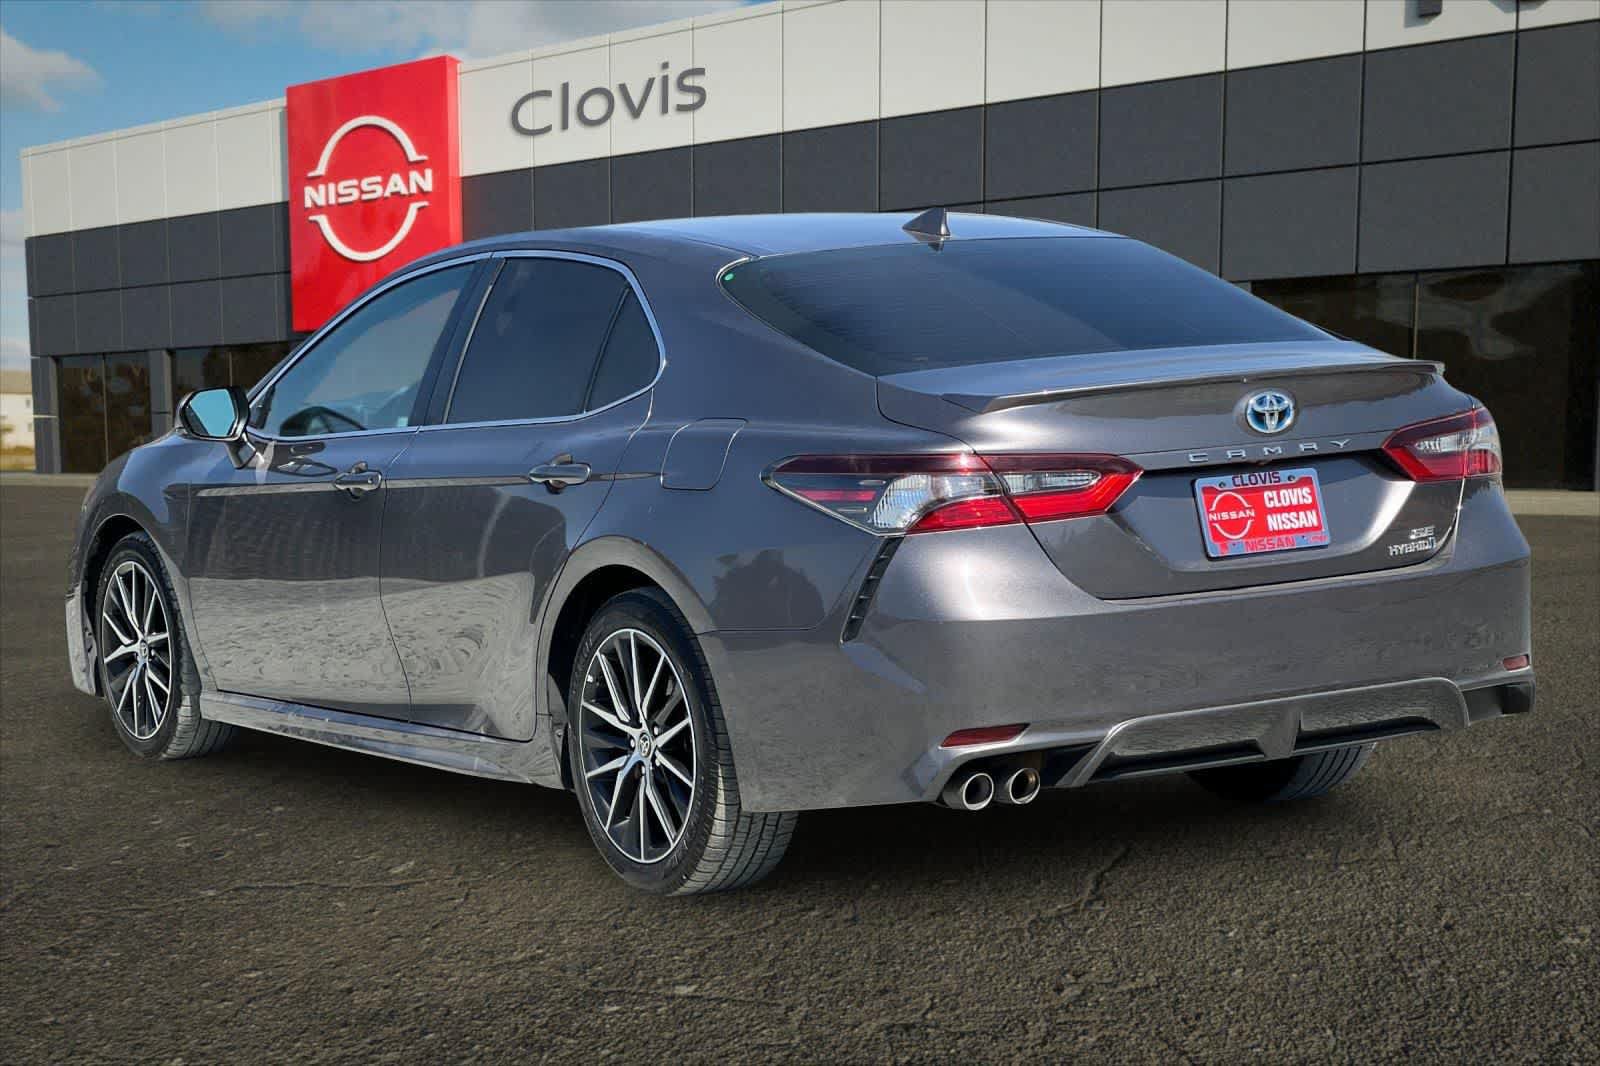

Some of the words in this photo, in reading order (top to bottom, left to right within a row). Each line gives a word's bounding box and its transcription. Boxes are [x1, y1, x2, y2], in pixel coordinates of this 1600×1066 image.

[511, 61, 708, 136] Clovis
[304, 167, 433, 209] NISSAN
[1188, 438, 1352, 463] CAMRY
[1232, 472, 1281, 487] CLOVIS
[1263, 487, 1313, 508] CLOVIS
[1208, 509, 1255, 522] NISSAN
[1267, 509, 1318, 531] NISSAN
[1245, 536, 1296, 552] NISSAN
[1388, 537, 1437, 556] HYBRID
